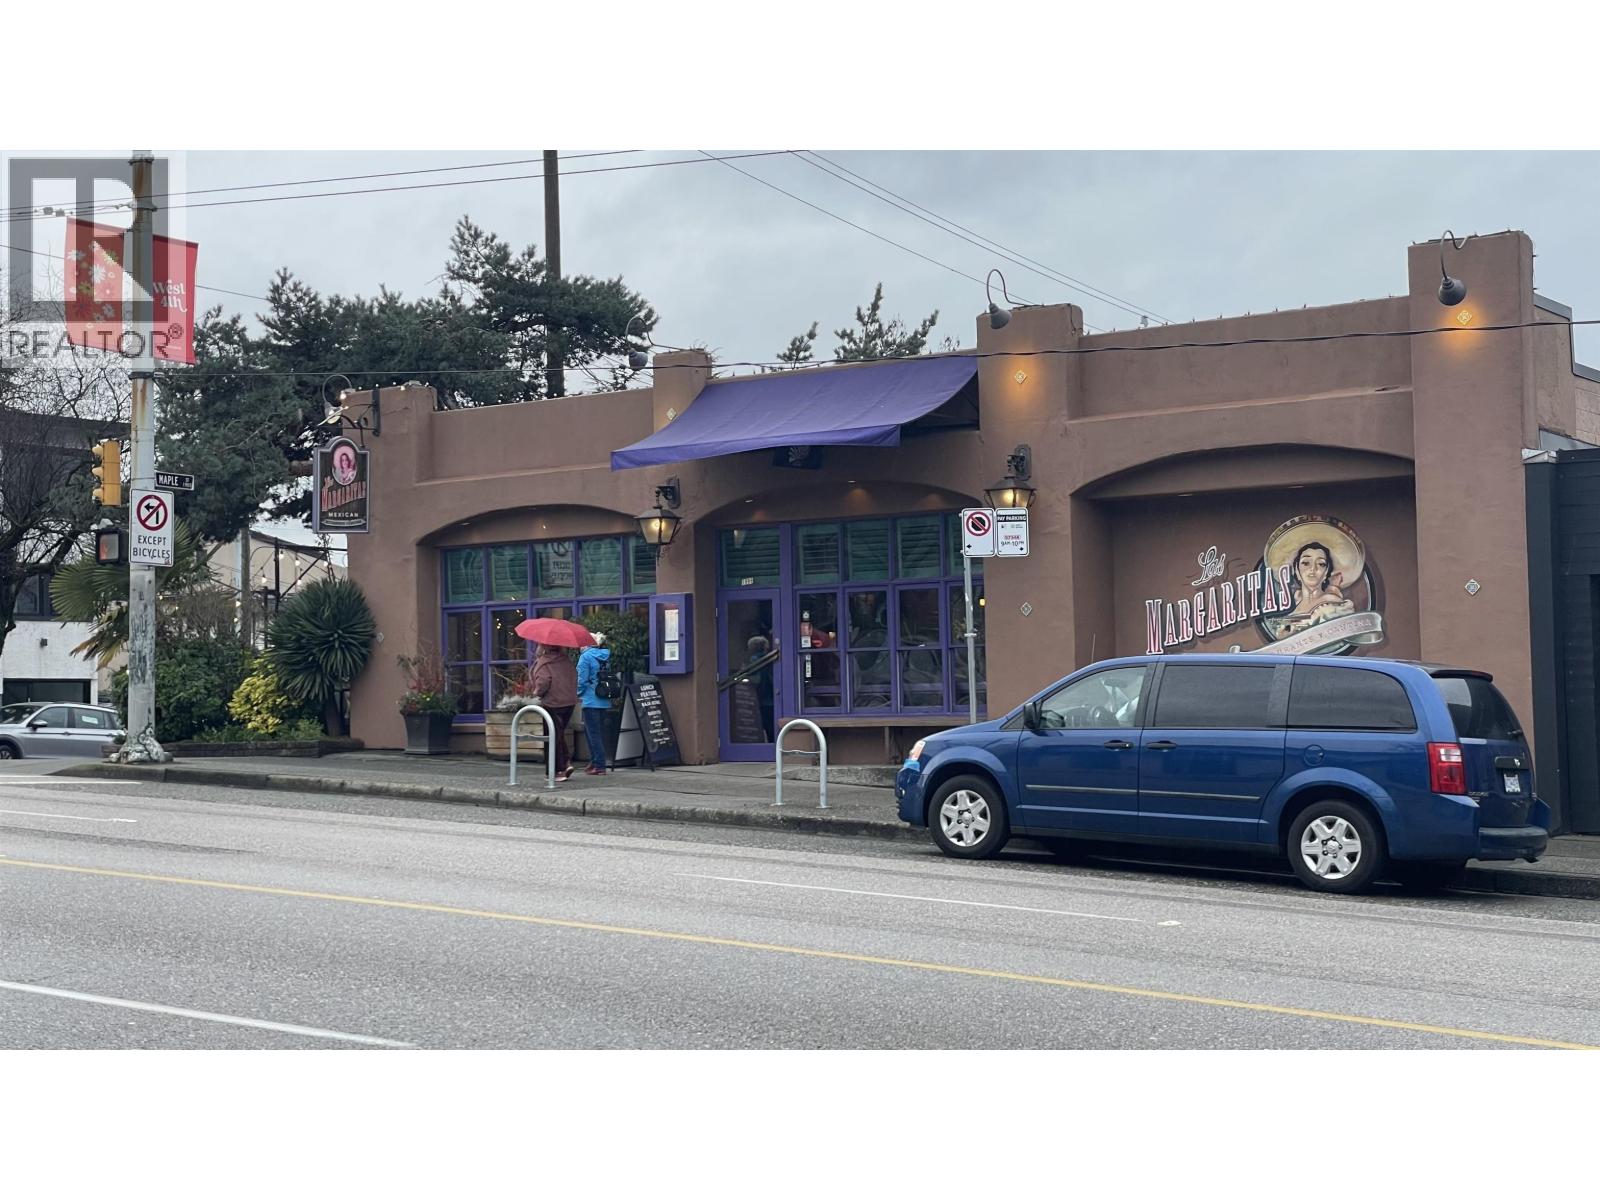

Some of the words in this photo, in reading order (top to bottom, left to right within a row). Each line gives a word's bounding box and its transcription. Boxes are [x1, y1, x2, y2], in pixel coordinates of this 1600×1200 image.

[153, 279, 186, 295] West
[161, 295, 188, 313] 4th
[158, 474, 179, 487] MAPLE
[137, 534, 167, 546] EXCEPT
[132, 547, 171, 559] BICYCLES
[1191, 545, 1226, 586] Las
[1145, 564, 1292, 655] MARGARITAS
